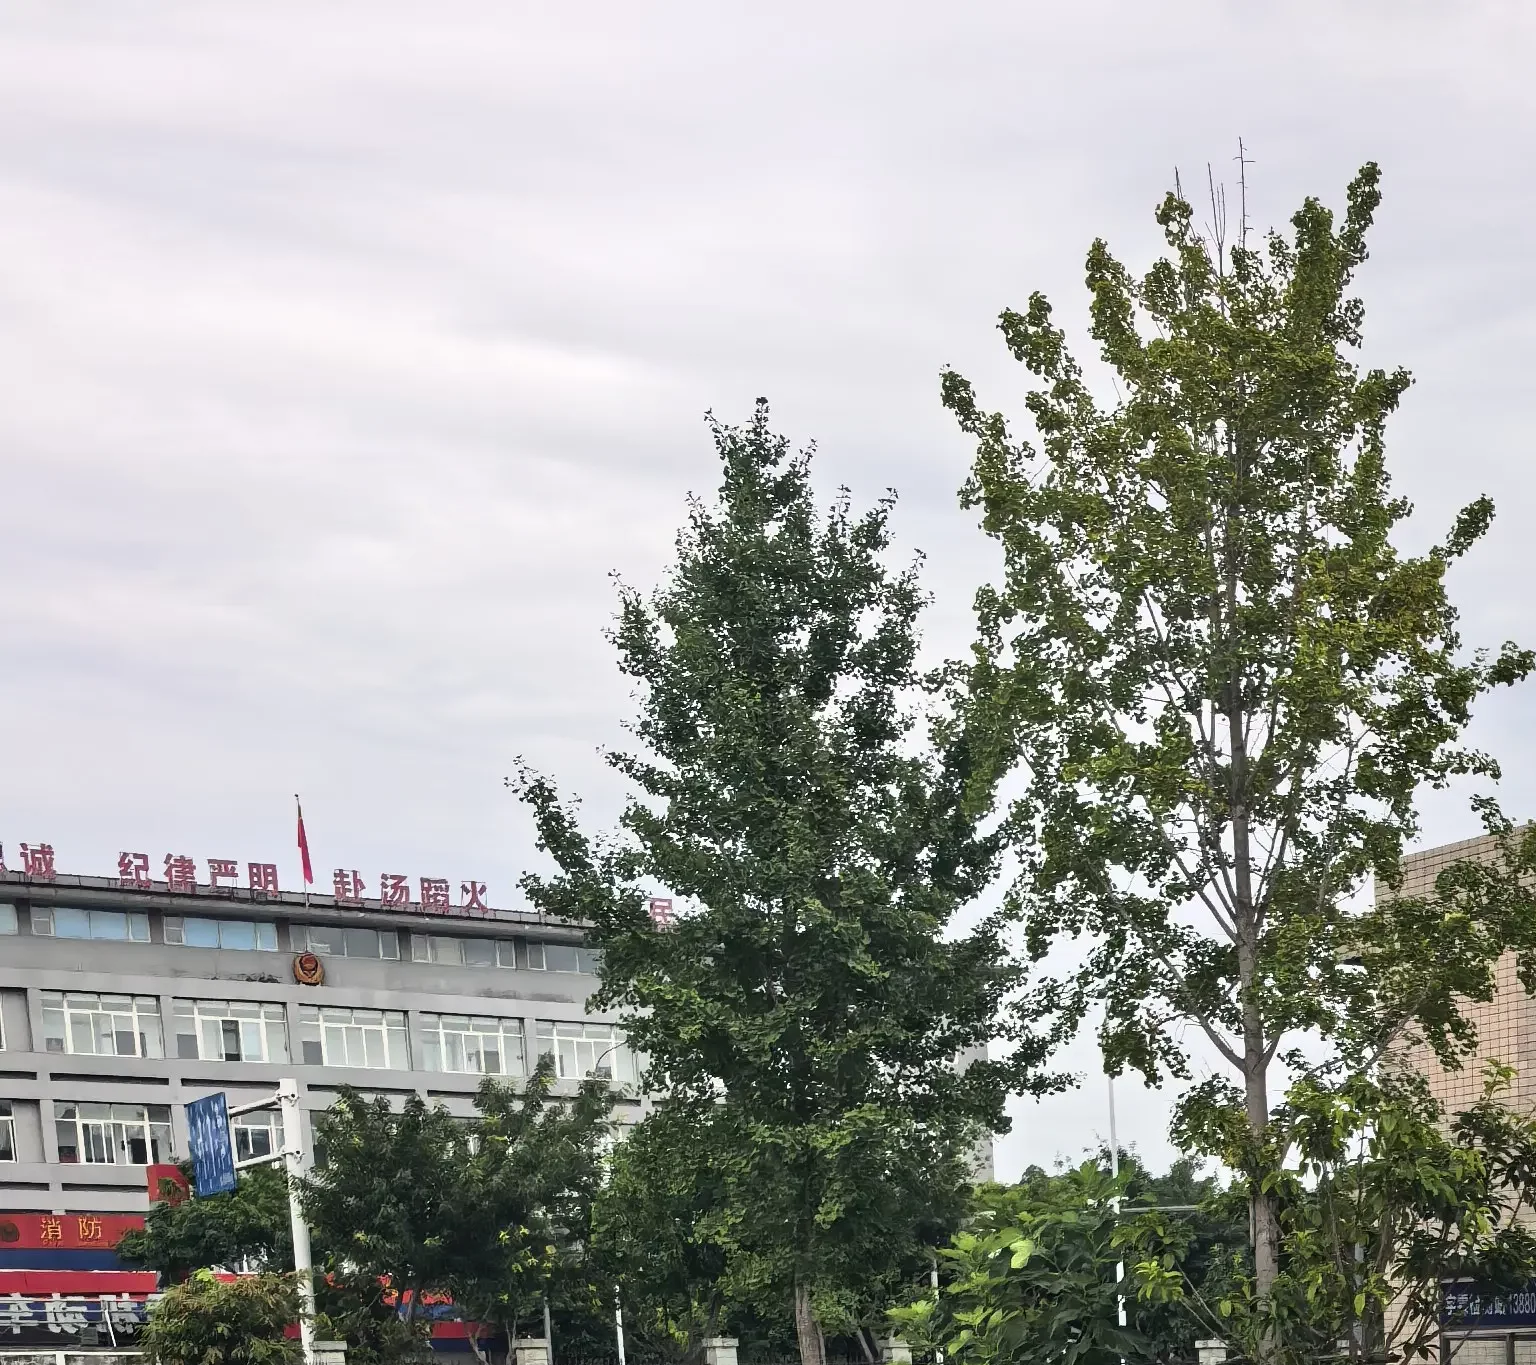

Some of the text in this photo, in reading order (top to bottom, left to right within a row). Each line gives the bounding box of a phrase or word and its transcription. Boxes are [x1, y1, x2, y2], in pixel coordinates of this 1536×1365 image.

[0, 842, 57, 882] 诚
[118, 851, 280, 898] 纪律严明
[333, 867, 489, 914] 赴汤蹈火
[40, 1215, 103, 1240] 消防
